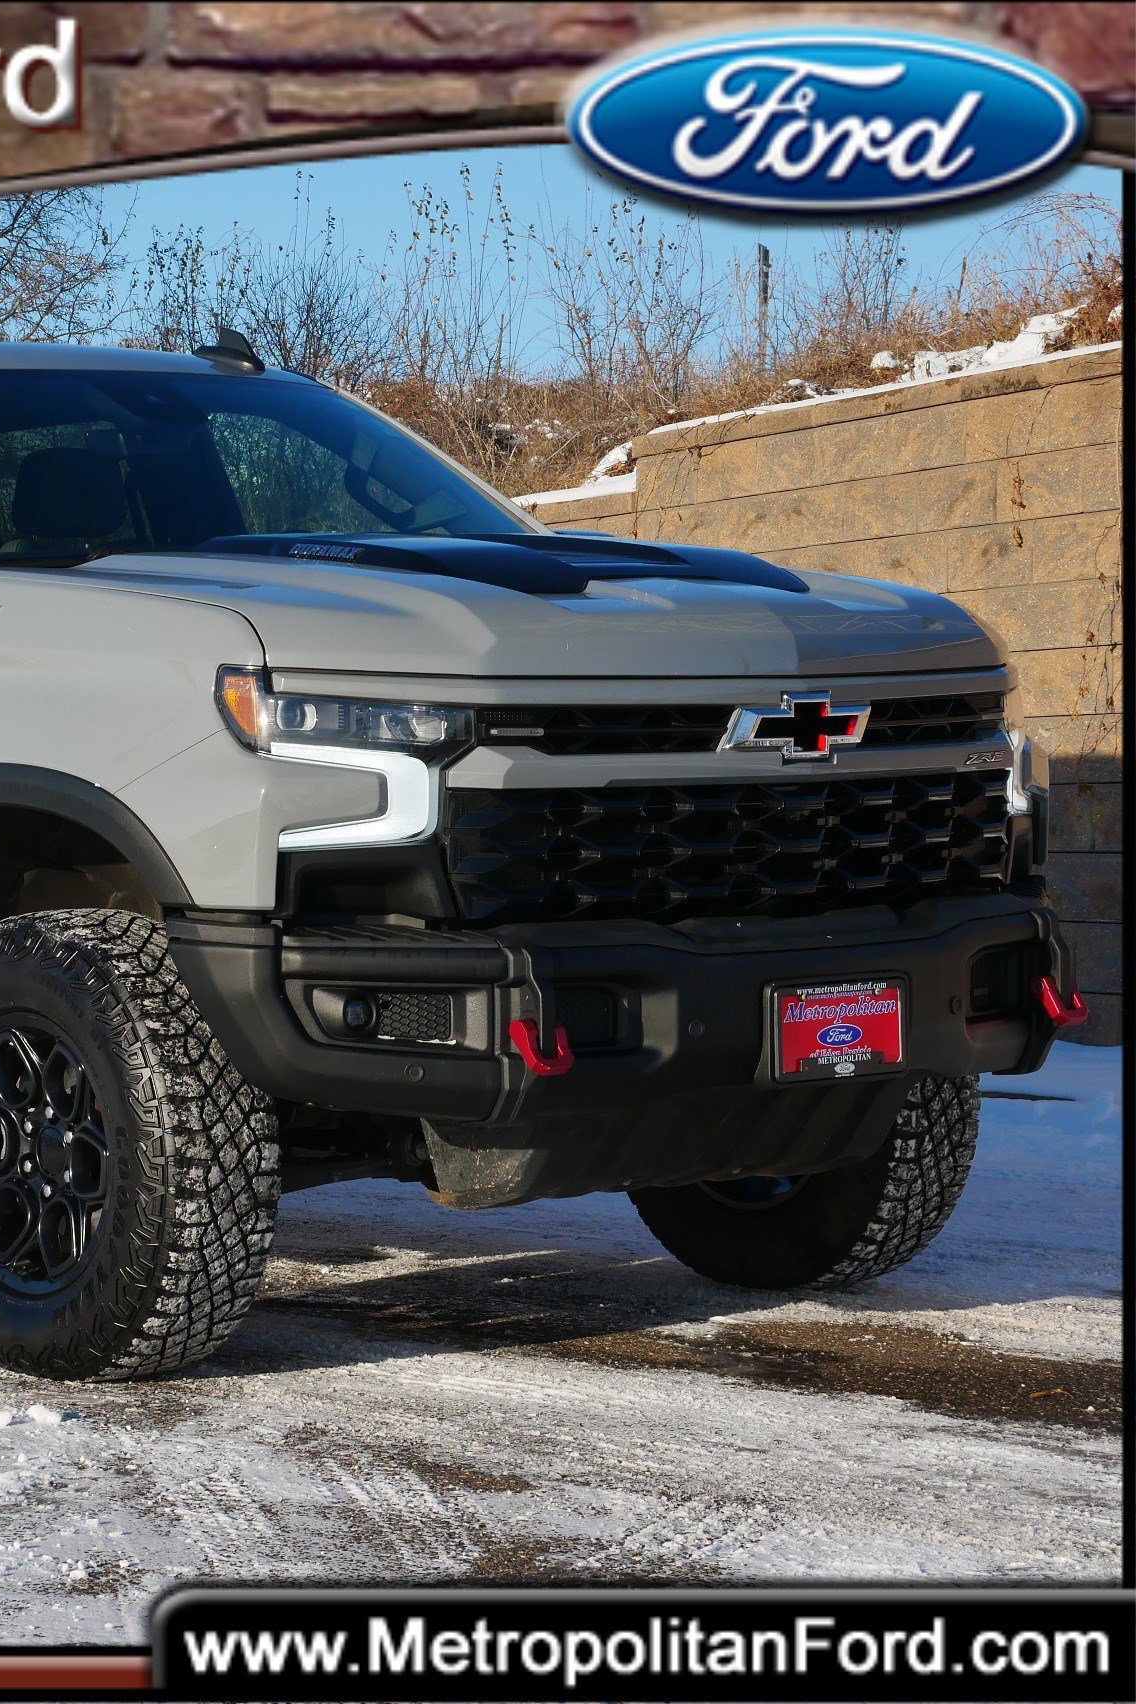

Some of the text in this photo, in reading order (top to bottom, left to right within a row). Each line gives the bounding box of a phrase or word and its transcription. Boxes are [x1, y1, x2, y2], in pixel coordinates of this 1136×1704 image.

[964, 749, 1006, 765] ZR2
[796, 982, 887, 995] www.metropolitanford.com
[783, 996, 896, 1025] Metropolitan
[826, 1028, 853, 1043] Ford
[817, 1053, 872, 1065] METROPOLITAN
